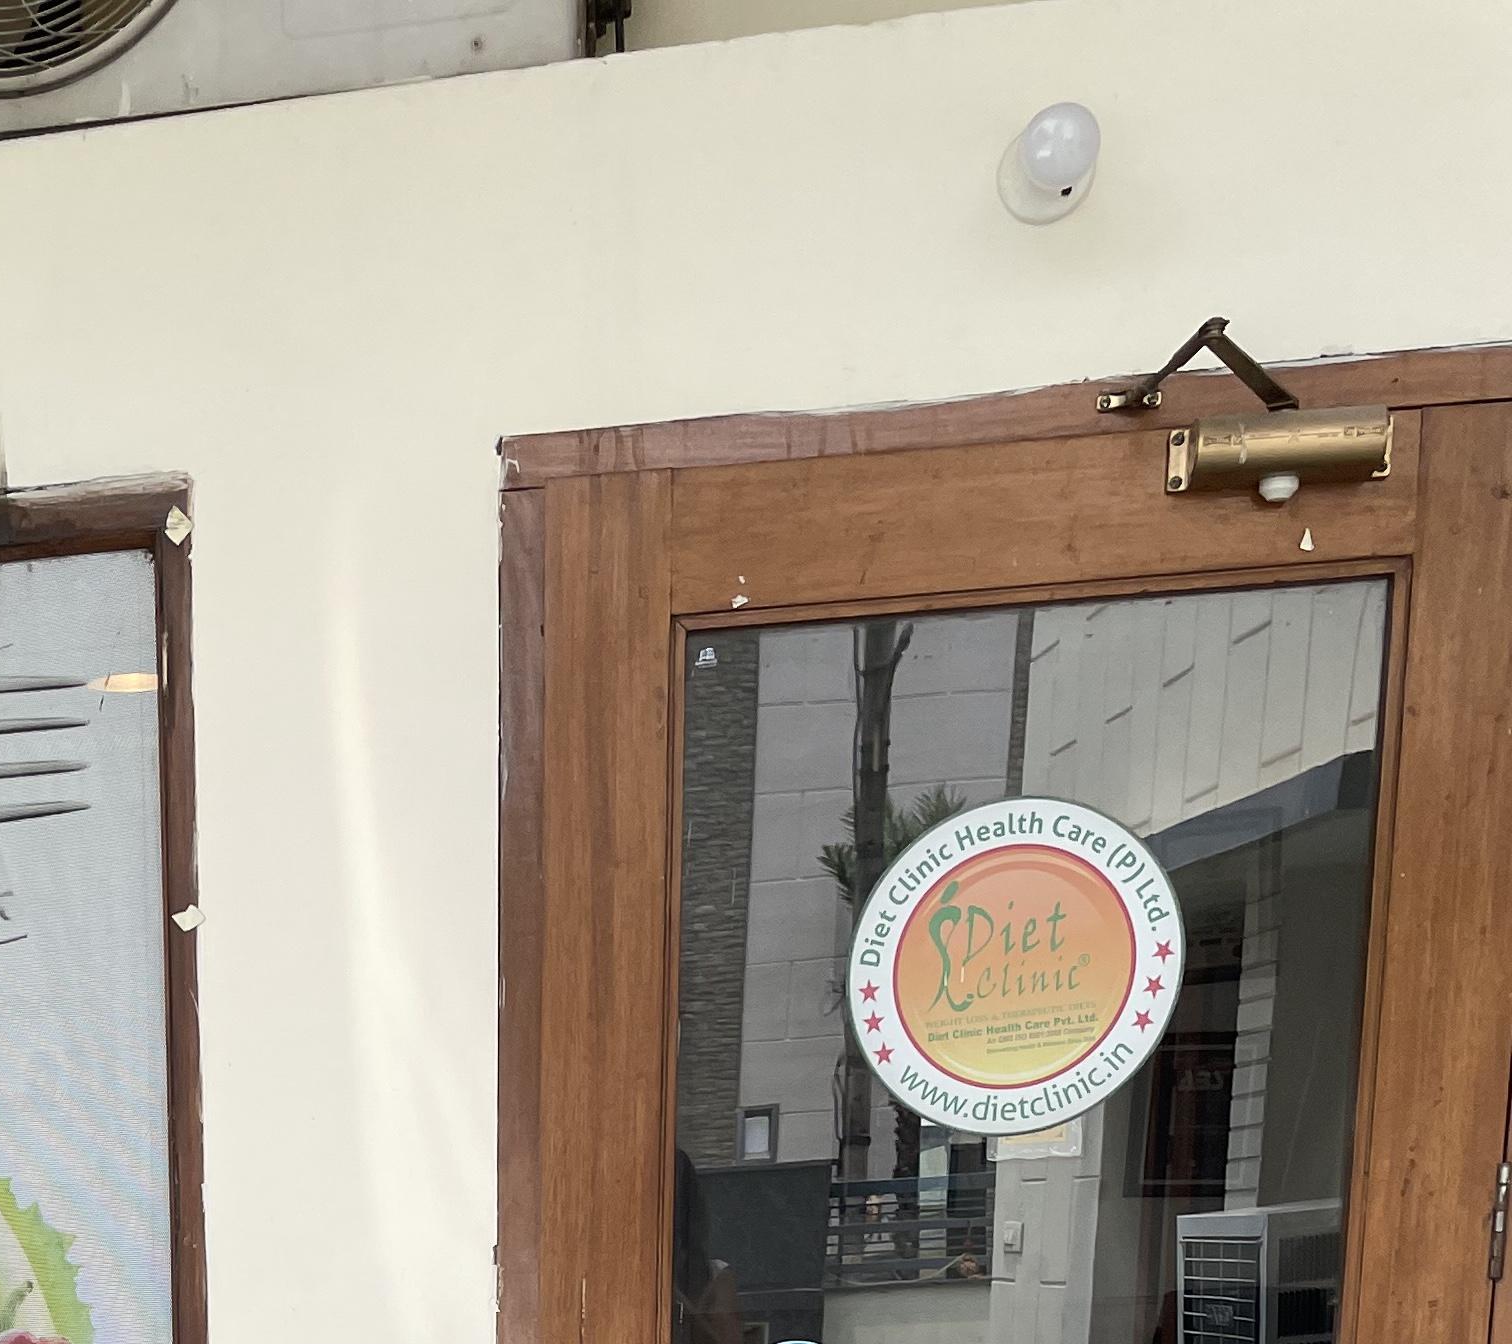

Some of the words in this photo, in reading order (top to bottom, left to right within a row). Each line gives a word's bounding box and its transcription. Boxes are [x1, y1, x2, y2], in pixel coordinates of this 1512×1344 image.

[859, 910, 897, 967] Diet
[888, 843, 953, 905] Clinic
[954, 811, 1043, 851] Health
[1052, 815, 1107, 854] Care
[962, 901, 1067, 967] Diet
[952, 1028, 983, 1040] Clinic
[986, 1023, 1022, 1036] Health
[1025, 1019, 1050, 1031] Care
[1053, 1016, 1075, 1027] Pvt.
[1078, 1012, 1099, 1024] Ltd.
[899, 1040, 1135, 1122] www.dietclinic.in
